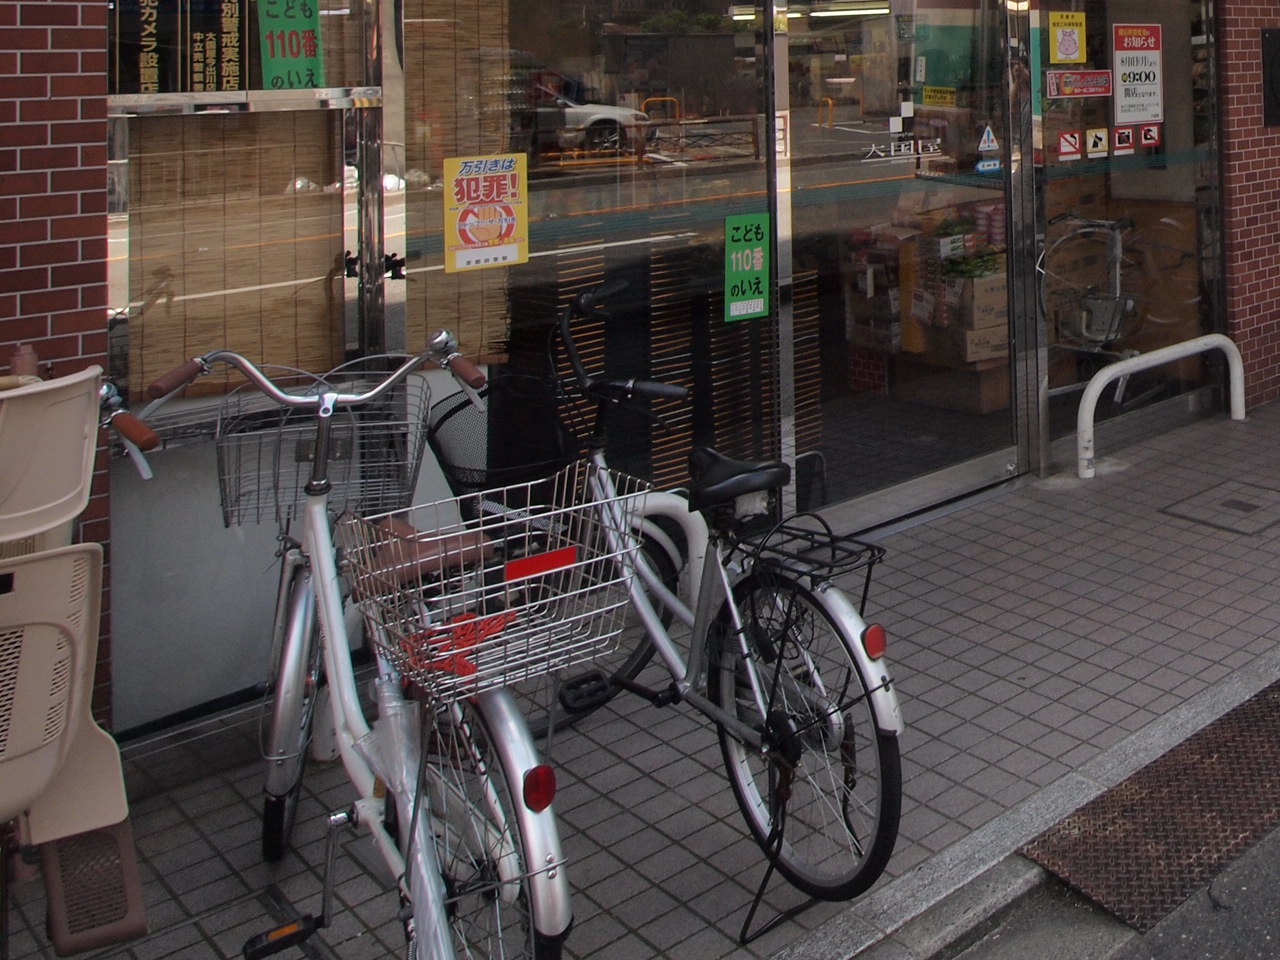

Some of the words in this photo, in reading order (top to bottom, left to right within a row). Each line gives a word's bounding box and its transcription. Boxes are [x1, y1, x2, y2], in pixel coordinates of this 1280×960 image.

[266, 0, 314, 19] こども
[265, 29, 319, 58] 110番
[1123, 36, 1156, 48] お知らせ
[270, 68, 319, 88] のいえ
[861, 138, 942, 158] 大国屋
[459, 158, 516, 175] 万引きは
[731, 224, 764, 243] こども
[730, 246, 764, 272] 110番
[730, 277, 764, 297] のいえ
